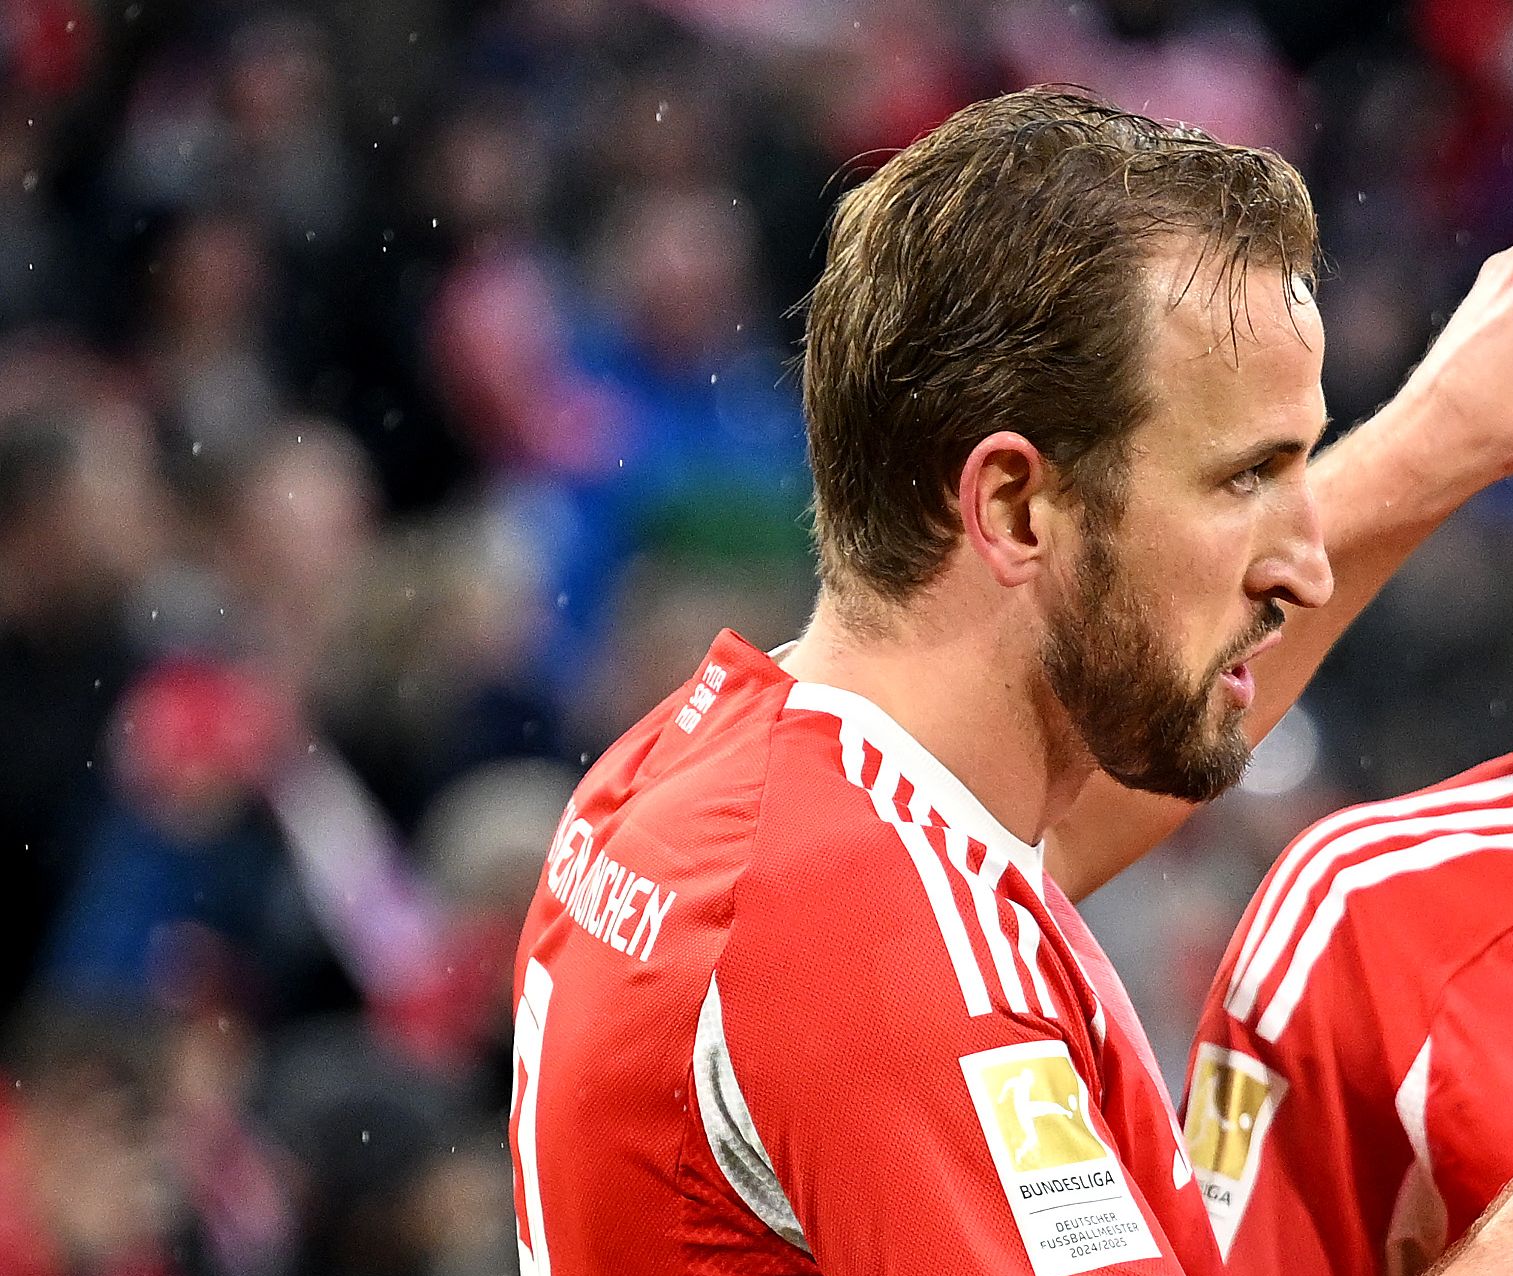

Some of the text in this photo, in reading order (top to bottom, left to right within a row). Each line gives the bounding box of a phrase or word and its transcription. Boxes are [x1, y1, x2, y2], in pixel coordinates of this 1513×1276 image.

[1019, 1170, 1116, 1200] BUNDESLIGA
[1055, 1212, 1118, 1233] DEUTSCHER
[1040, 1222, 1140, 1250] FUSSBALLMEISTER
[1069, 1237, 1128, 1259] 2024/2025
